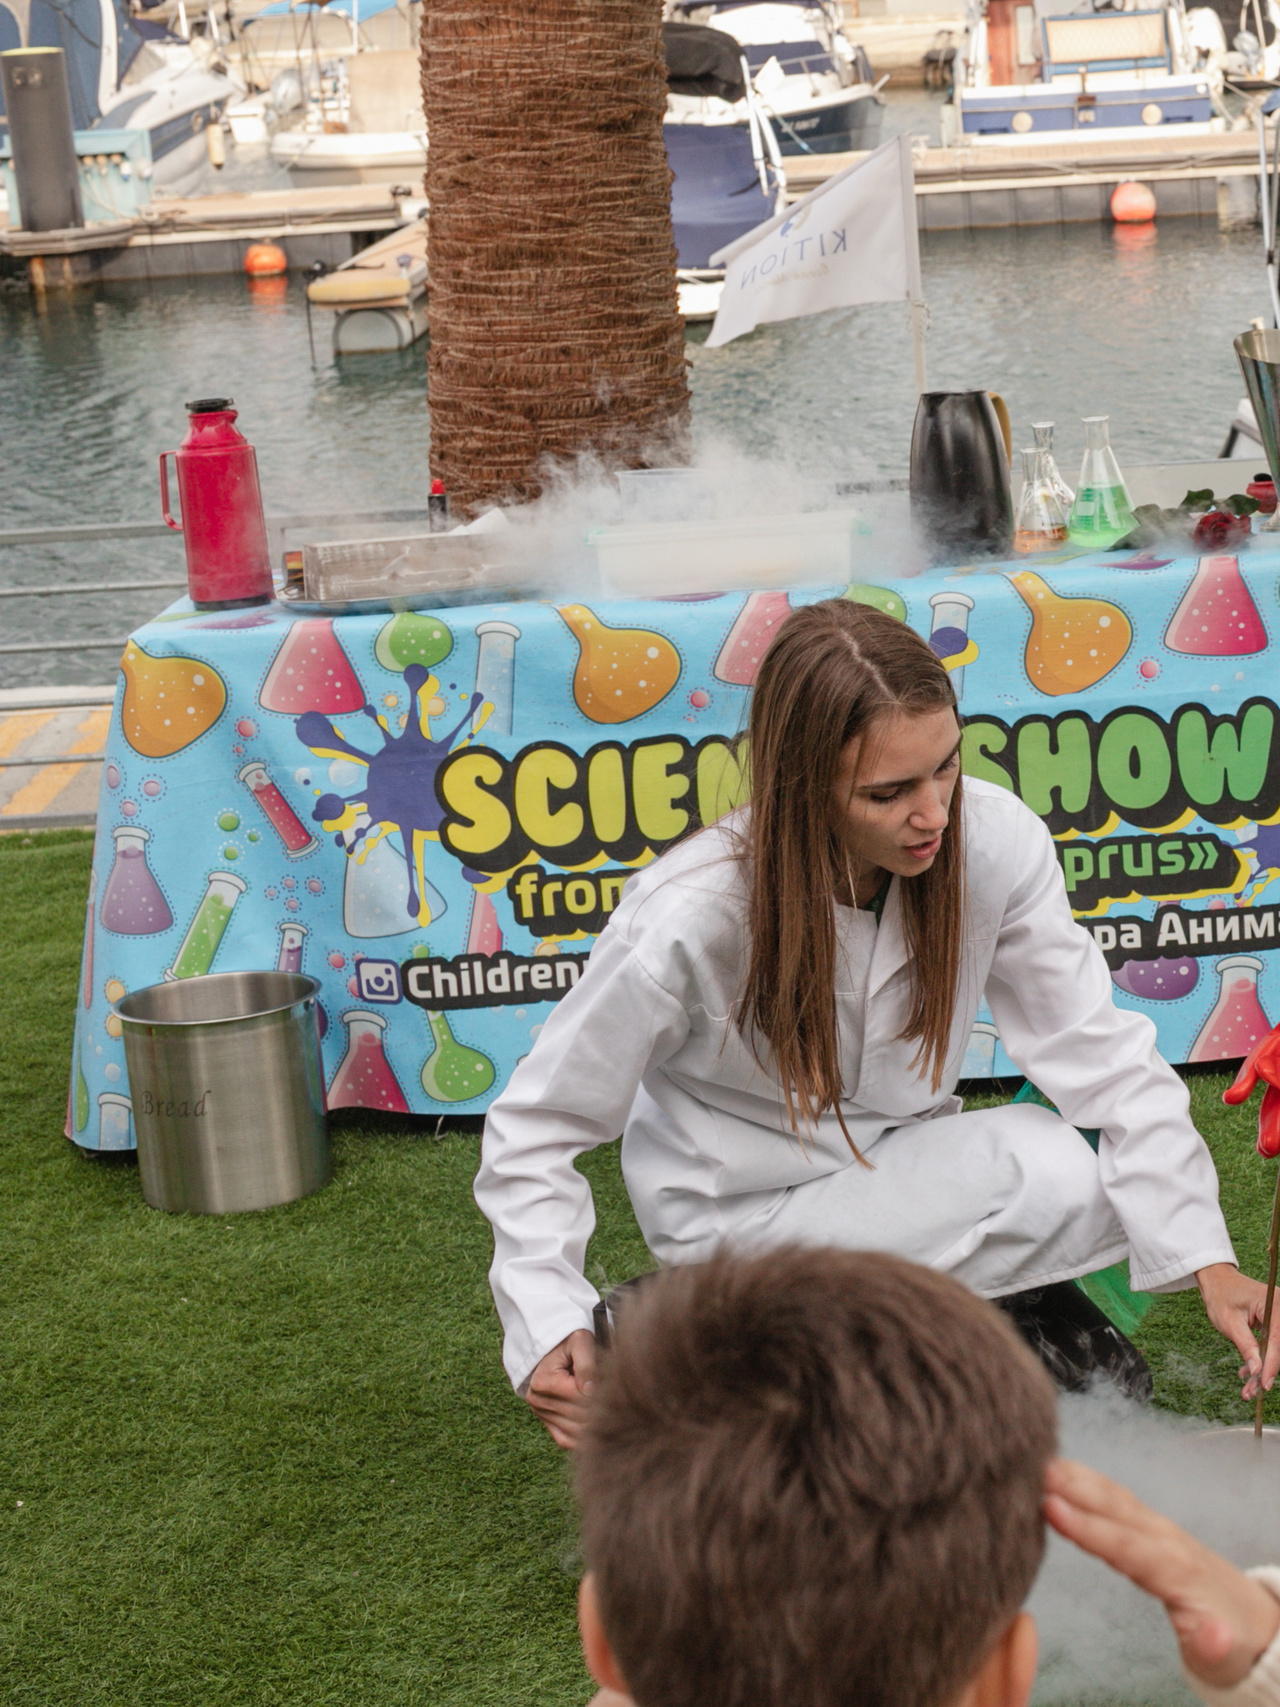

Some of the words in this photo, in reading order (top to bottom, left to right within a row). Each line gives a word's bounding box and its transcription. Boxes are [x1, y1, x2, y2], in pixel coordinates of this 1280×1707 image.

[443, 740, 752, 854] SCIEN
[960, 704, 1274, 816] SHOW
[1063, 840, 1220, 892] prus»
[1086, 923, 1142, 954] ра
[407, 958, 590, 999] Children
[141, 1090, 212, 1117] Bread
